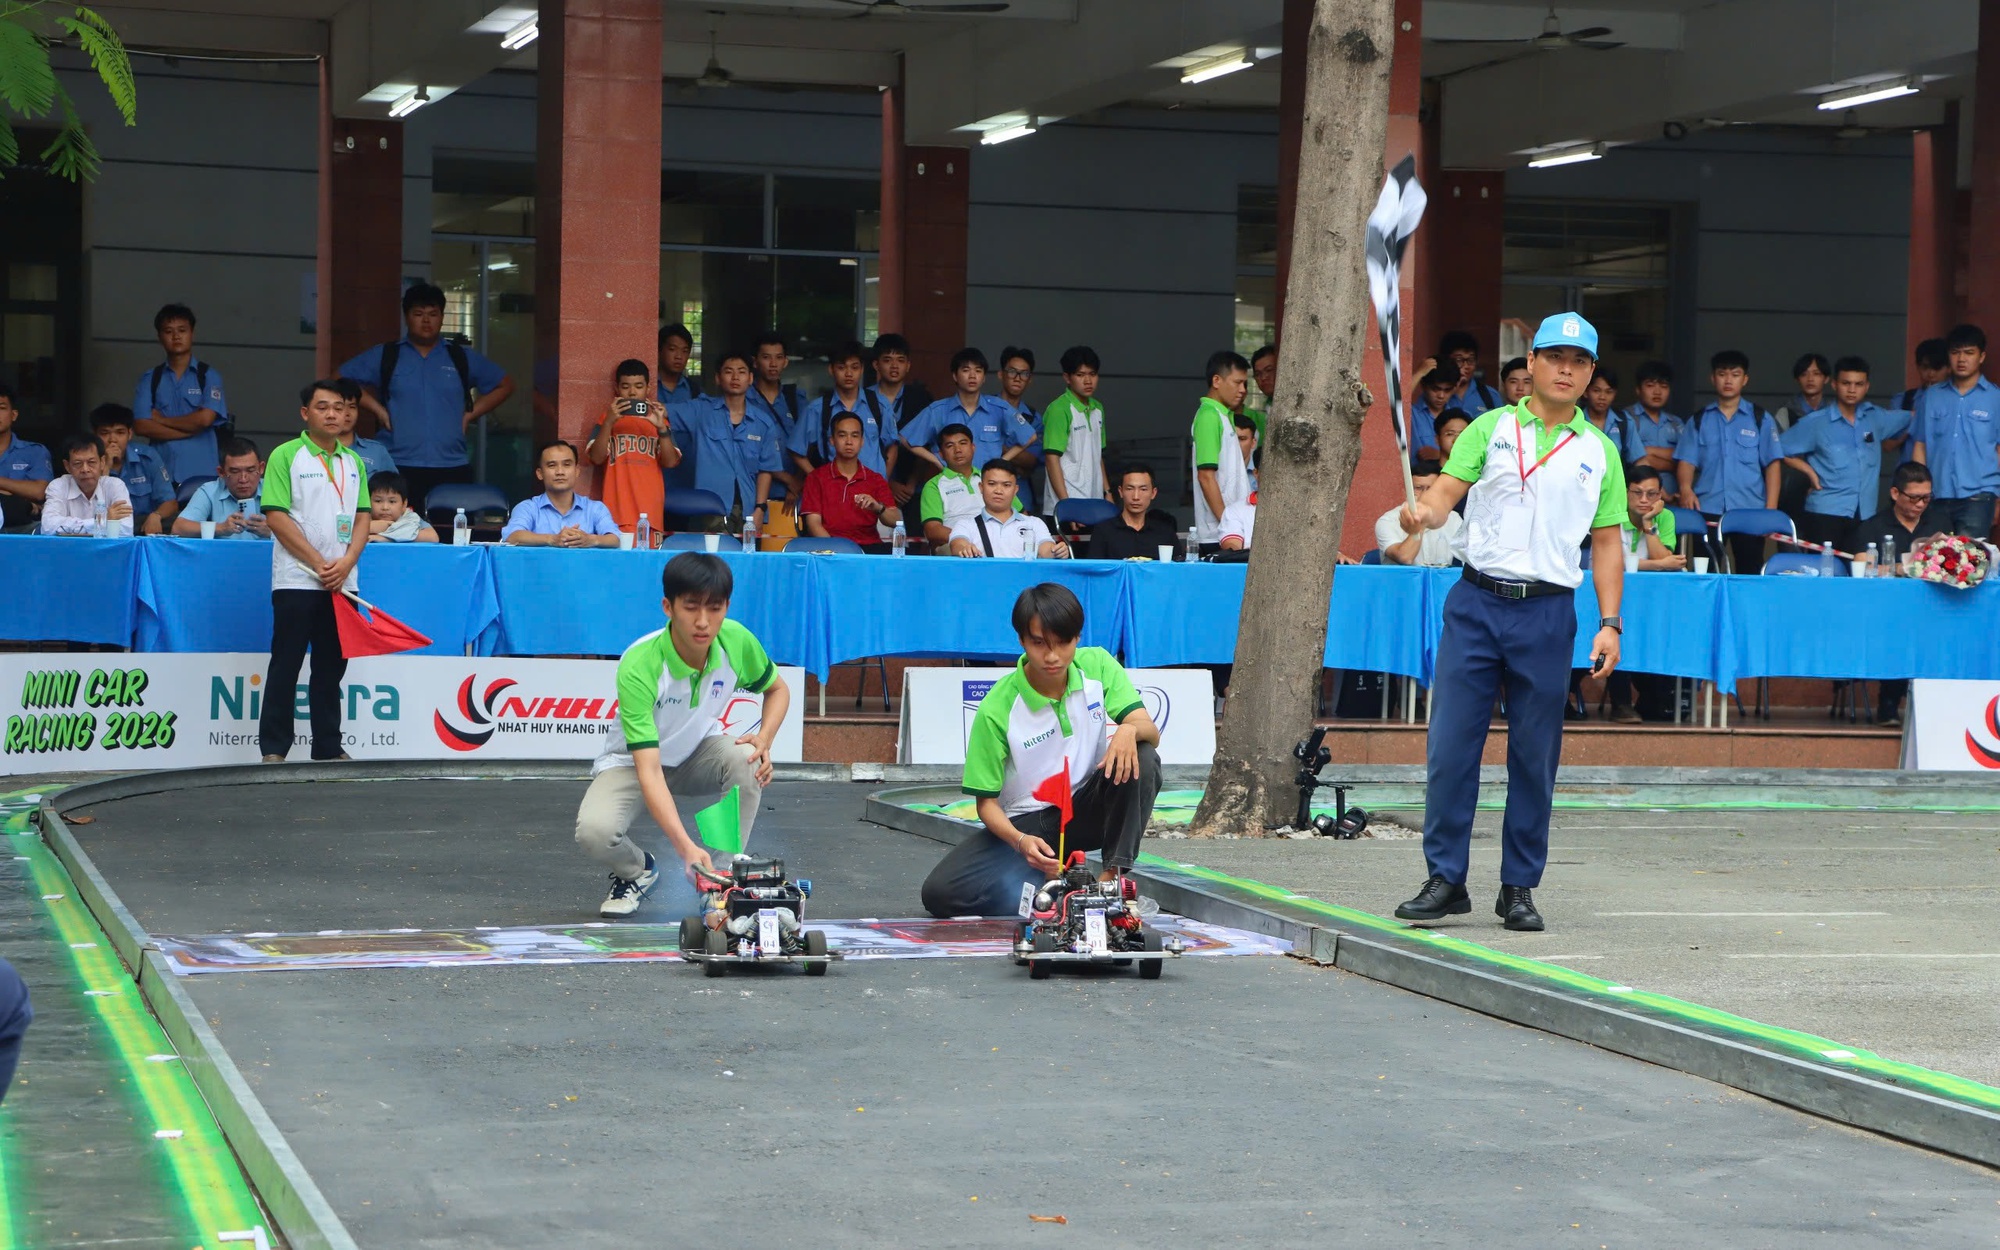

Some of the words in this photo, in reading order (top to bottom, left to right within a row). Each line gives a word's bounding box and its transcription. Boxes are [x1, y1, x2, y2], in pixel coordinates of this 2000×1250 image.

[21, 669, 81, 710] MINI
[84, 668, 149, 709] CAR
[210, 674, 400, 721] Niera
[971, 690, 985, 698] CAO
[4, 711, 97, 755] RACING
[100, 711, 178, 750] 2026
[371, 731, 400, 746] Ltd.
[498, 722, 528, 733] NHAT
[531, 723, 554, 733] HUY
[556, 723, 595, 734] KHANG
[1023, 728, 1055, 749] Niterra
